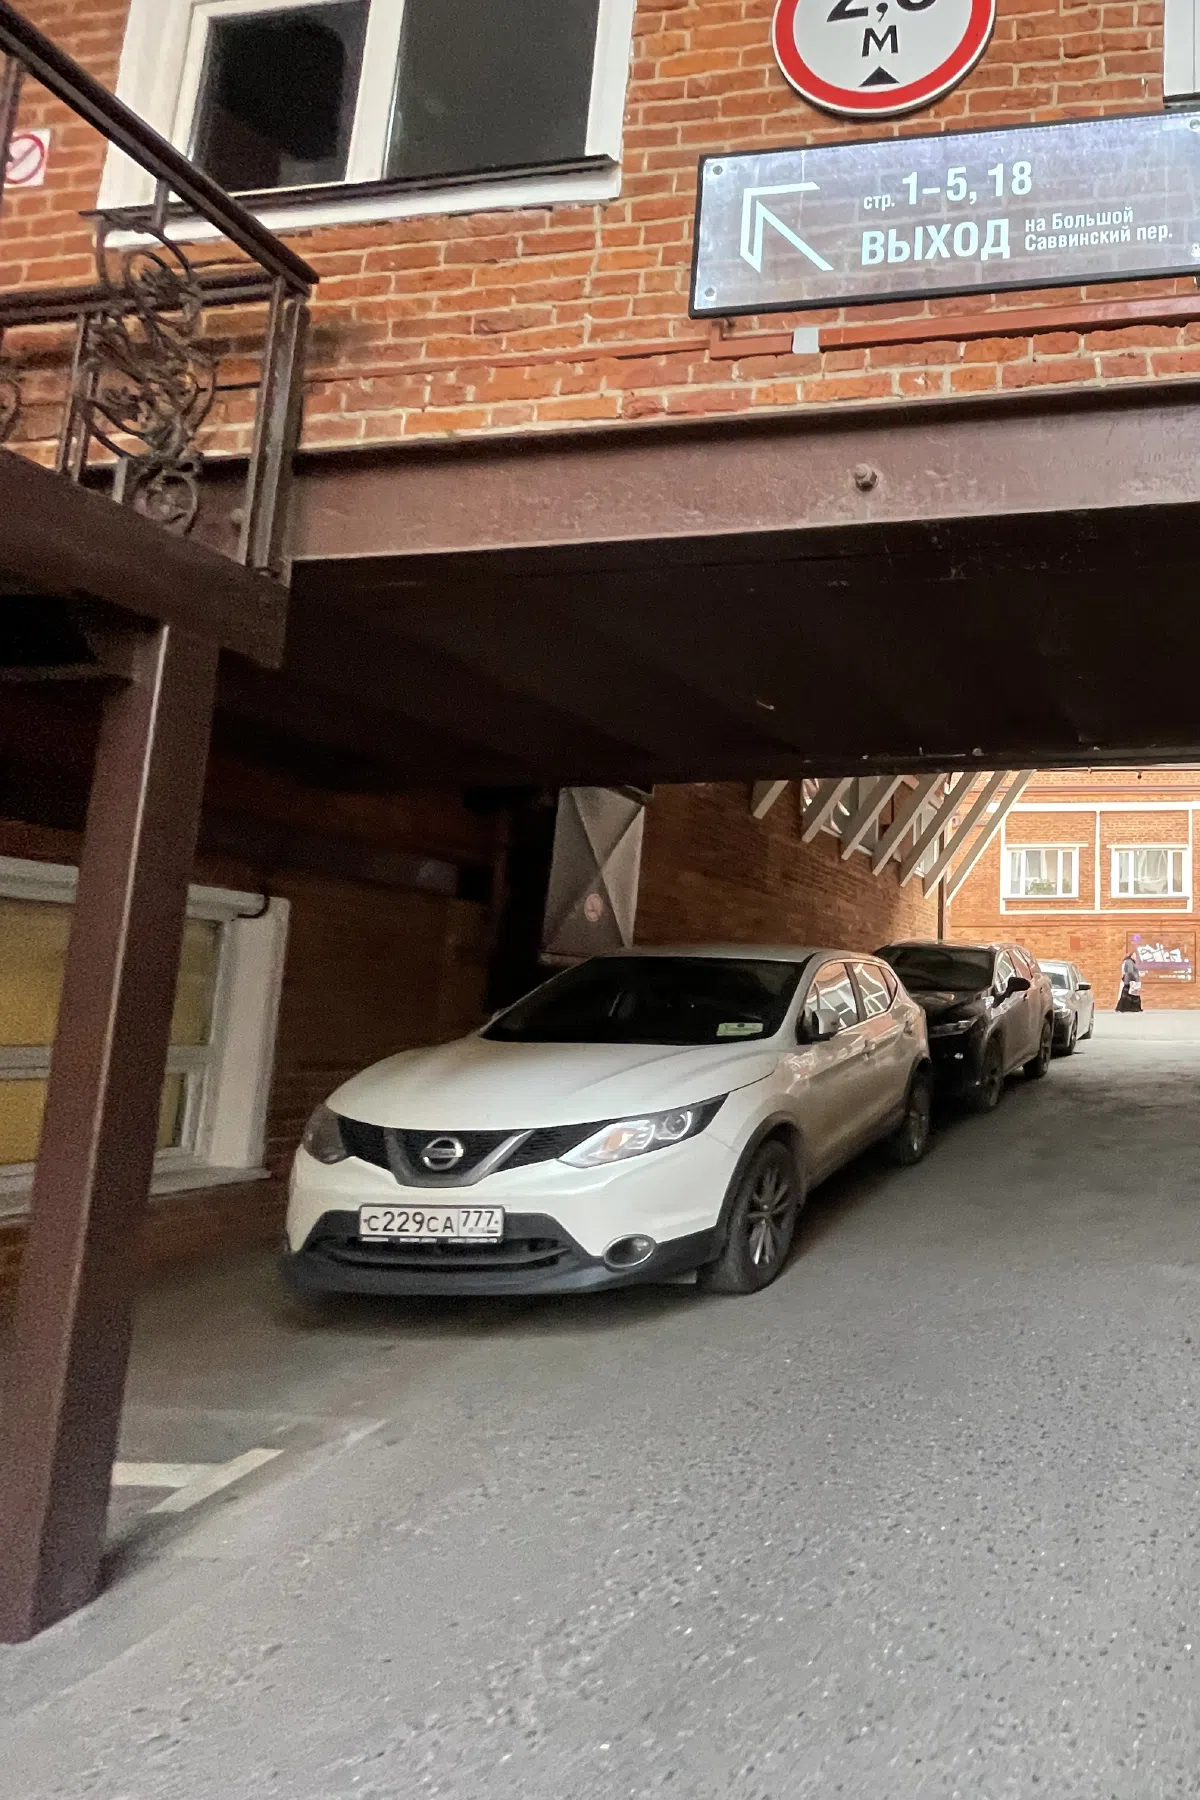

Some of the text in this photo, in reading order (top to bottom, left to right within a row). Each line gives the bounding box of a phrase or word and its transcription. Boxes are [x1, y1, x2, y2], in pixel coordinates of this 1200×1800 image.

[863, 194, 895, 211] стр.
[987, 160, 1032, 197] 18
[1025, 206, 1134, 233] на Большой
[861, 218, 1011, 266] ВЫХОД
[1024, 224, 1173, 251] Саввинский пер.
[367, 1210, 495, 1233] С229СА 777
